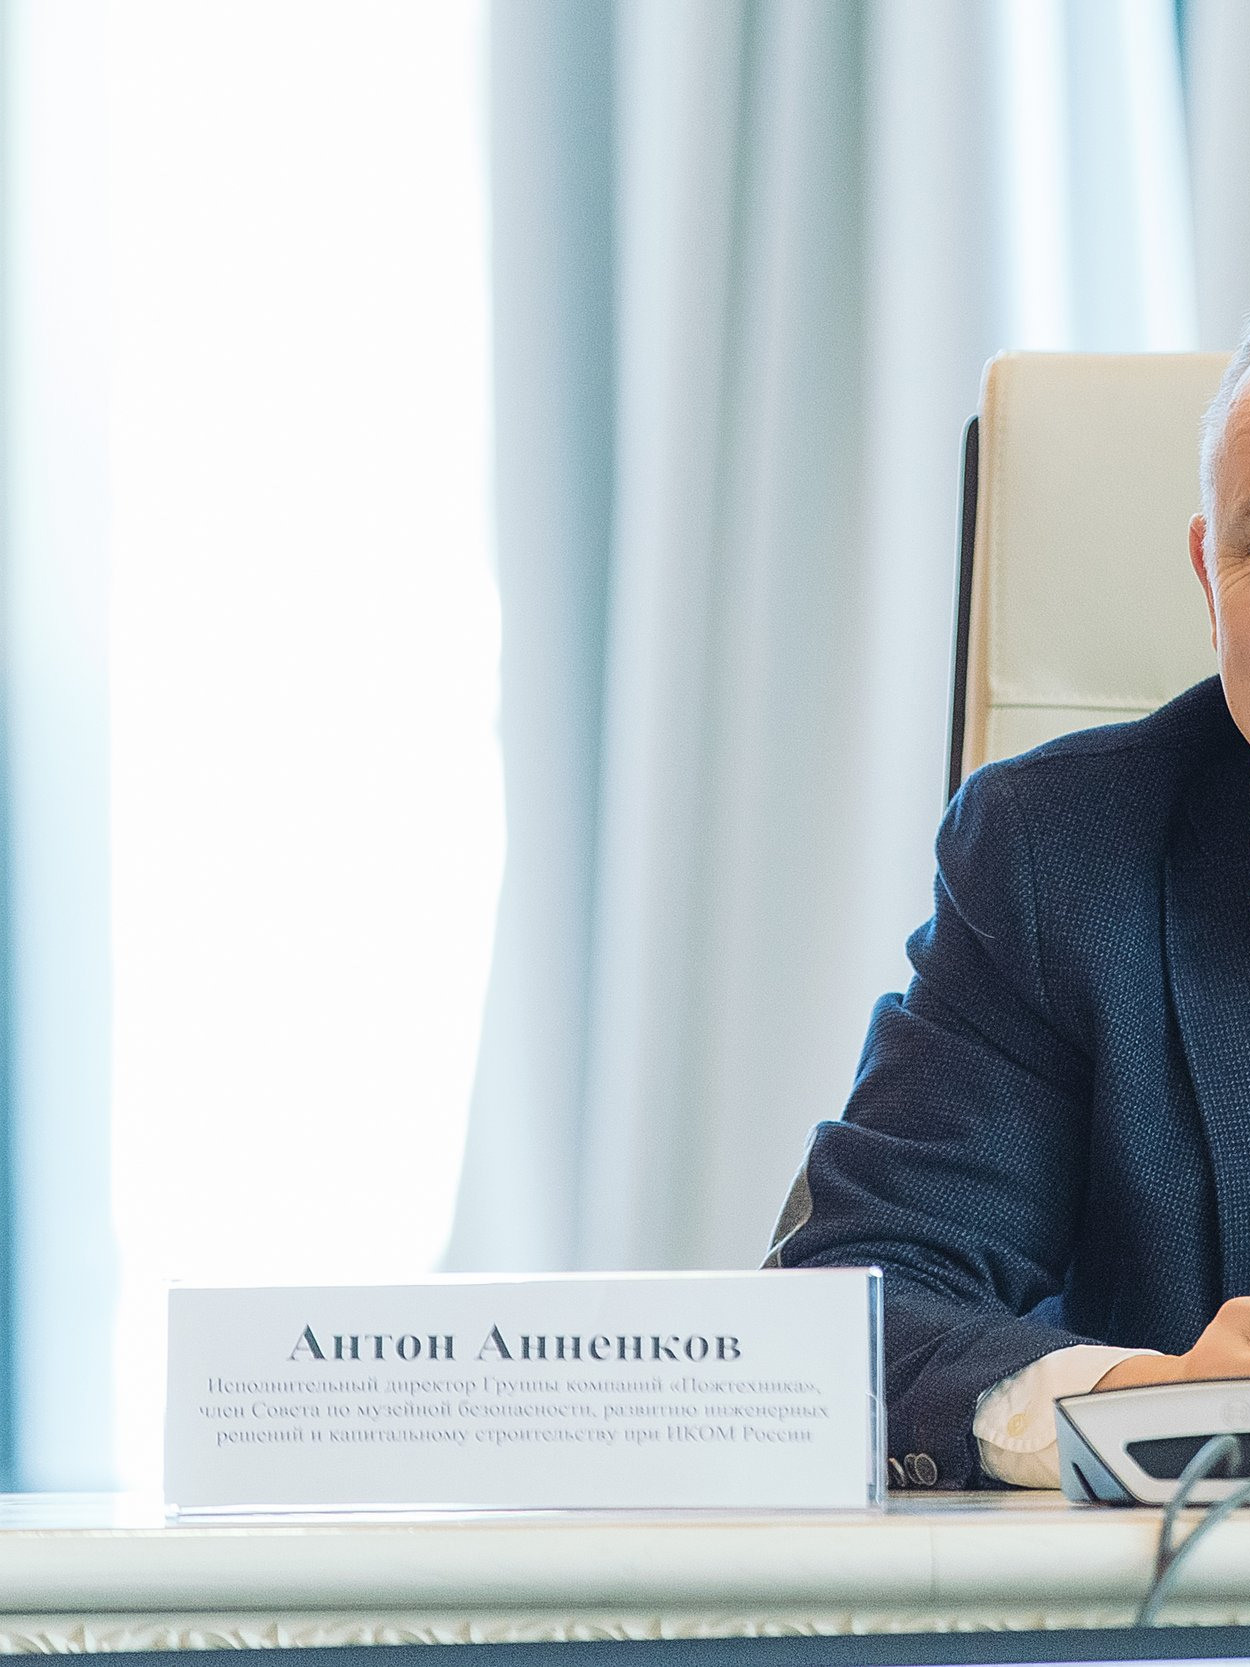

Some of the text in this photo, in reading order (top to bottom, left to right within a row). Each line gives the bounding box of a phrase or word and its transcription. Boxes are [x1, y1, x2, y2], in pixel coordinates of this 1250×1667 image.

[287, 1323, 743, 1361] Антон Анненков
[207, 1376, 822, 1396] Исполнительный директор Группы компаний «Пожтехника»,
[199, 1399, 831, 1421] член Совета по музейной безопасности, развитию инженерных
[216, 1424, 813, 1447] решений и капитальному строительству при ИКОМ России
